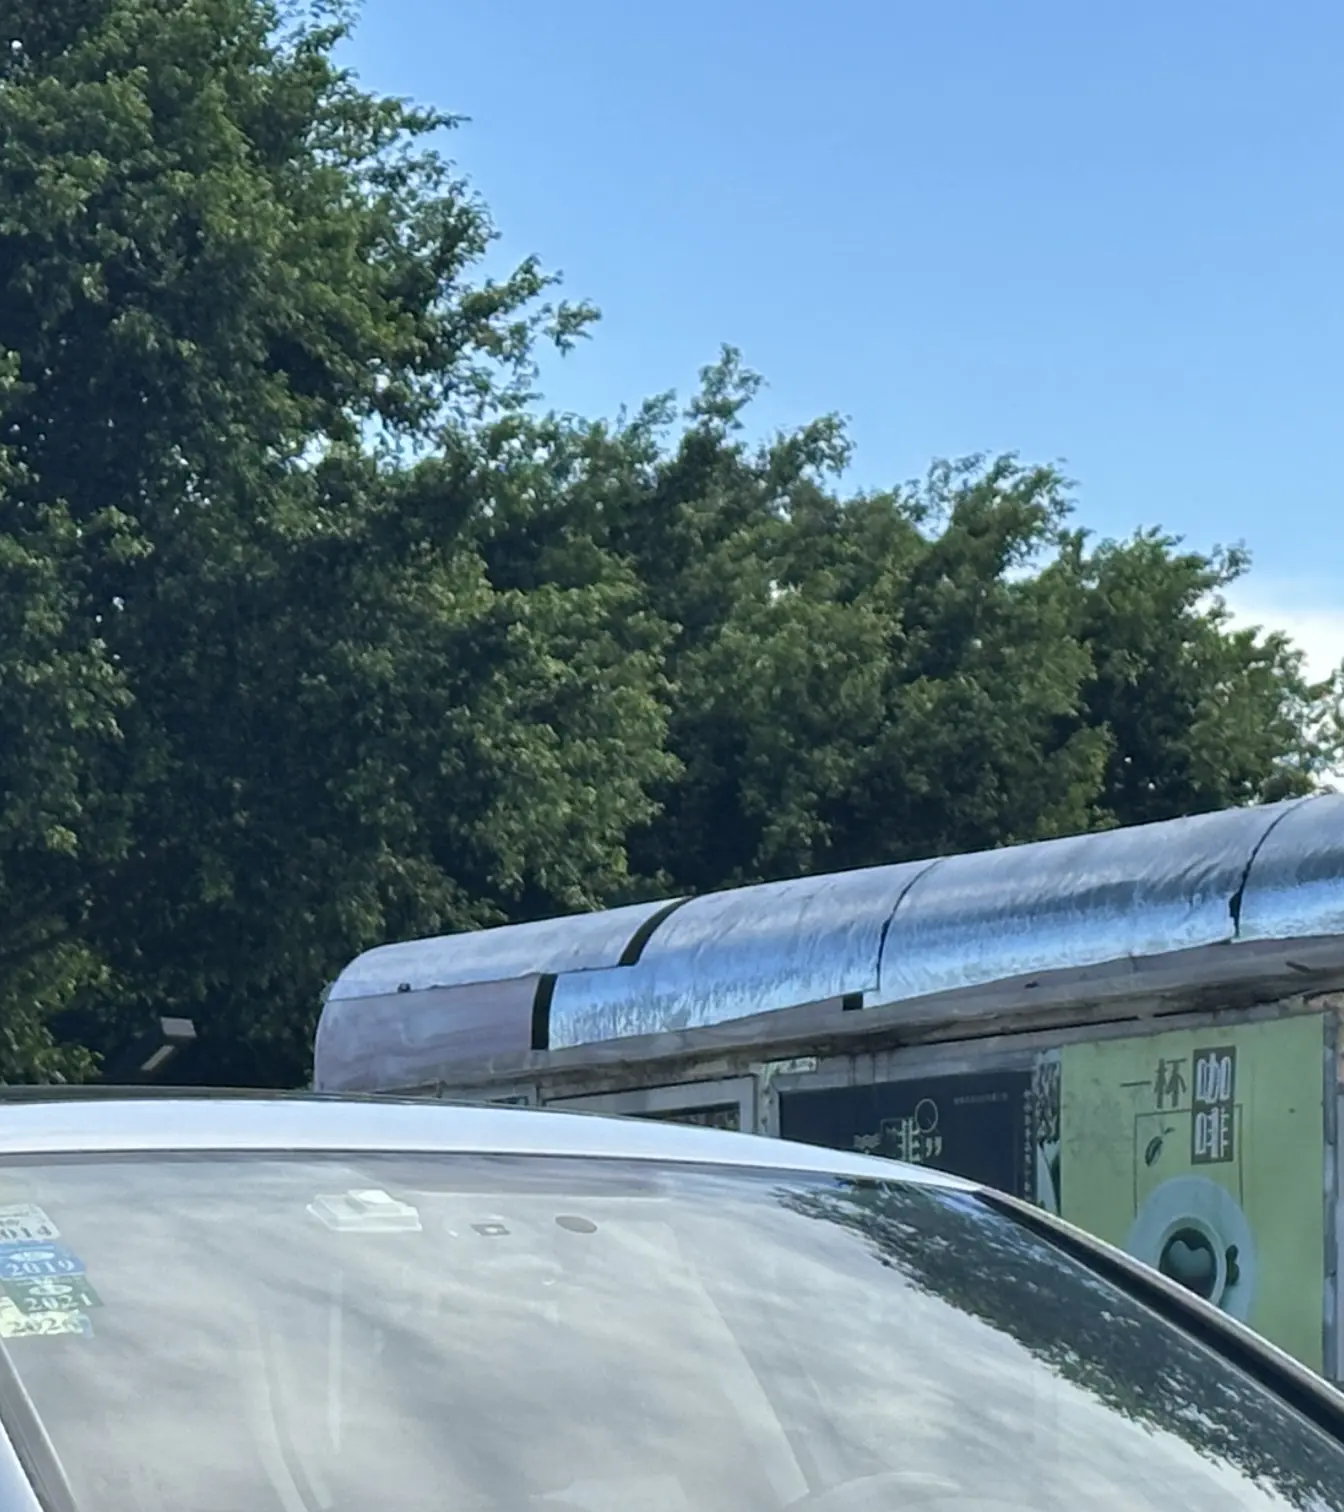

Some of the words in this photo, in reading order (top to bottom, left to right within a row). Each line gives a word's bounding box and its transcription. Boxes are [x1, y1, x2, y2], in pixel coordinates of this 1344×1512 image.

[1119, 1058, 1188, 1109] 一杯
[1194, 1052, 1232, 1158] 咖啡
[6, 1259, 76, 1277] 2019
